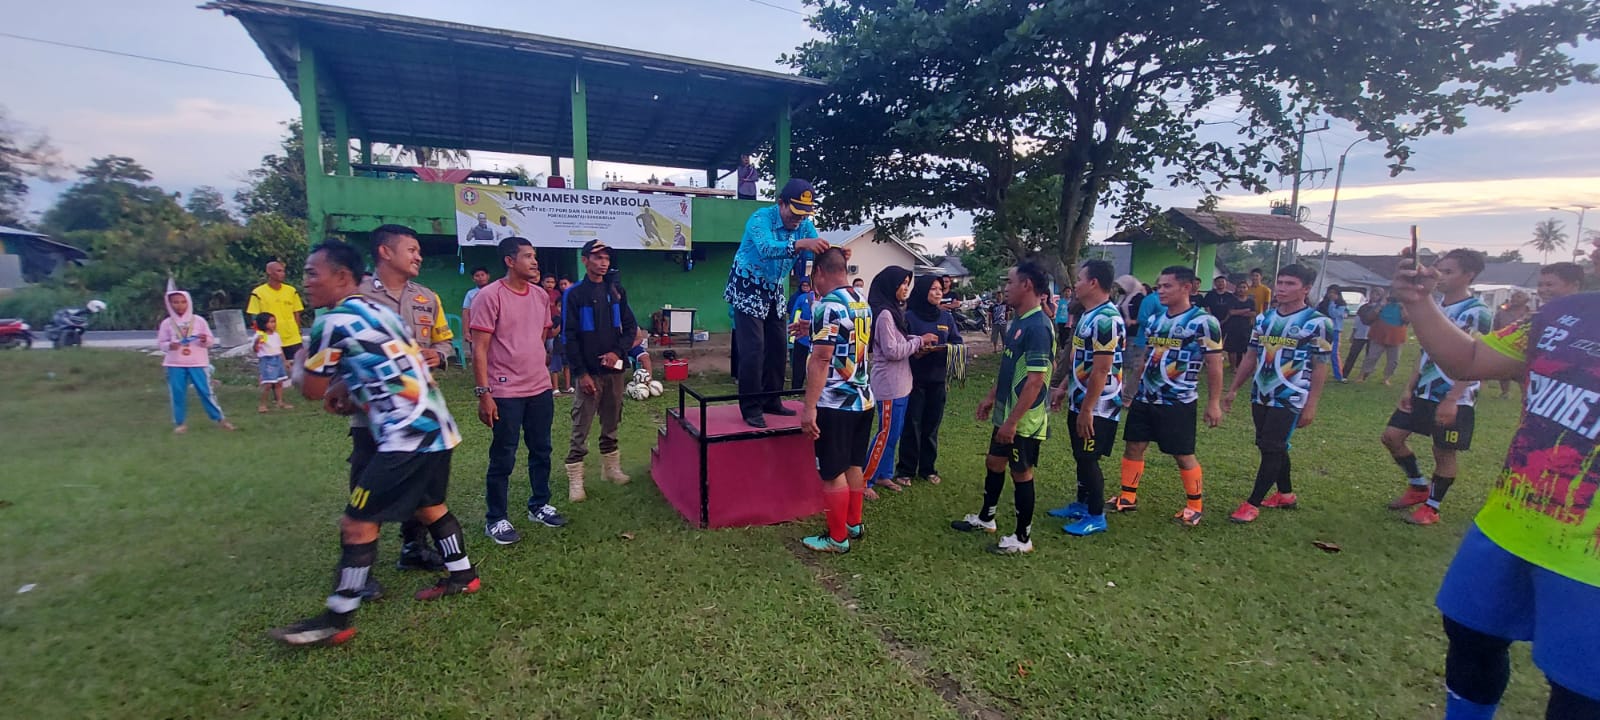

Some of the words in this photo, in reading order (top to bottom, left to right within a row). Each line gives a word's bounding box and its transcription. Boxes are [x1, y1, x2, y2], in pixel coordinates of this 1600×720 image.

[506, 191, 579, 203] TURNAMEN
[581, 195, 650, 207] SEPAKBOLA
[1536, 326, 1569, 352] 22
[1445, 430, 1459, 443] 18
[1083, 439, 1095, 452] 12
[1012, 448, 1020, 463] 5
